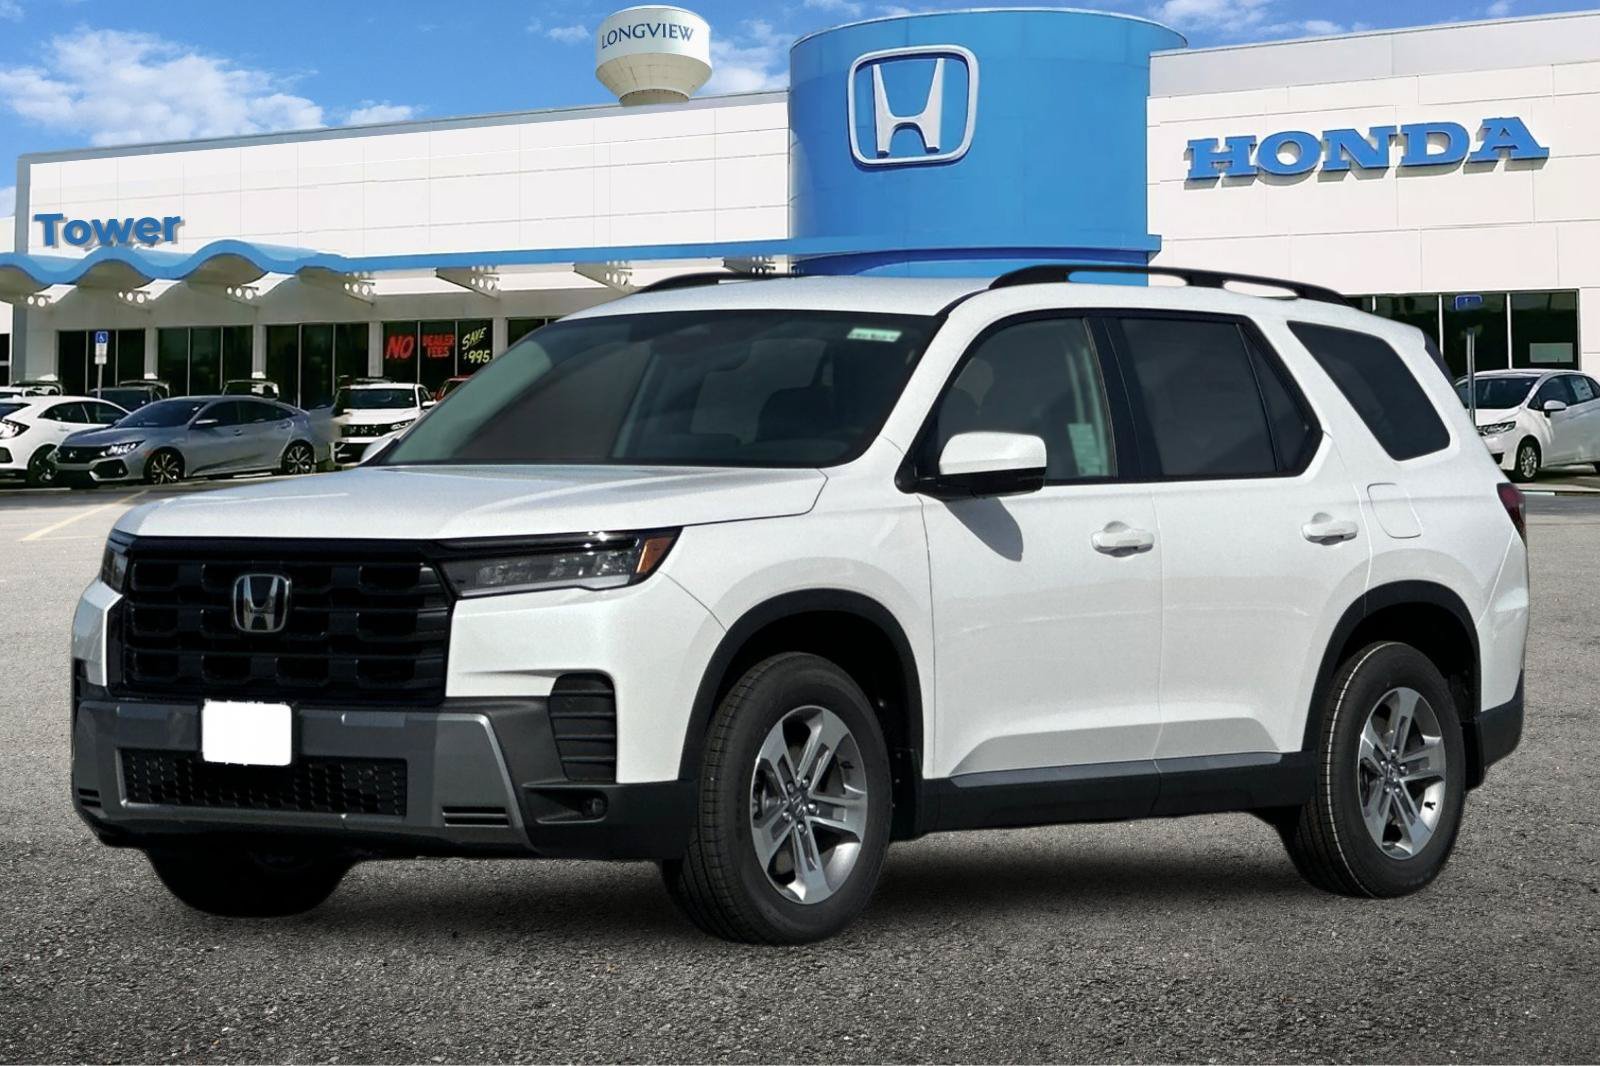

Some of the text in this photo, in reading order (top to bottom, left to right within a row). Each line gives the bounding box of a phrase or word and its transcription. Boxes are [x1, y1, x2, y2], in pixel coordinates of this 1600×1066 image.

[602, 23, 694, 49] LONGVIEW
[1185, 116, 1550, 186] HONDA
[33, 213, 183, 247] Tower
[385, 335, 416, 359] NO
[462, 327, 487, 350] SAVE
